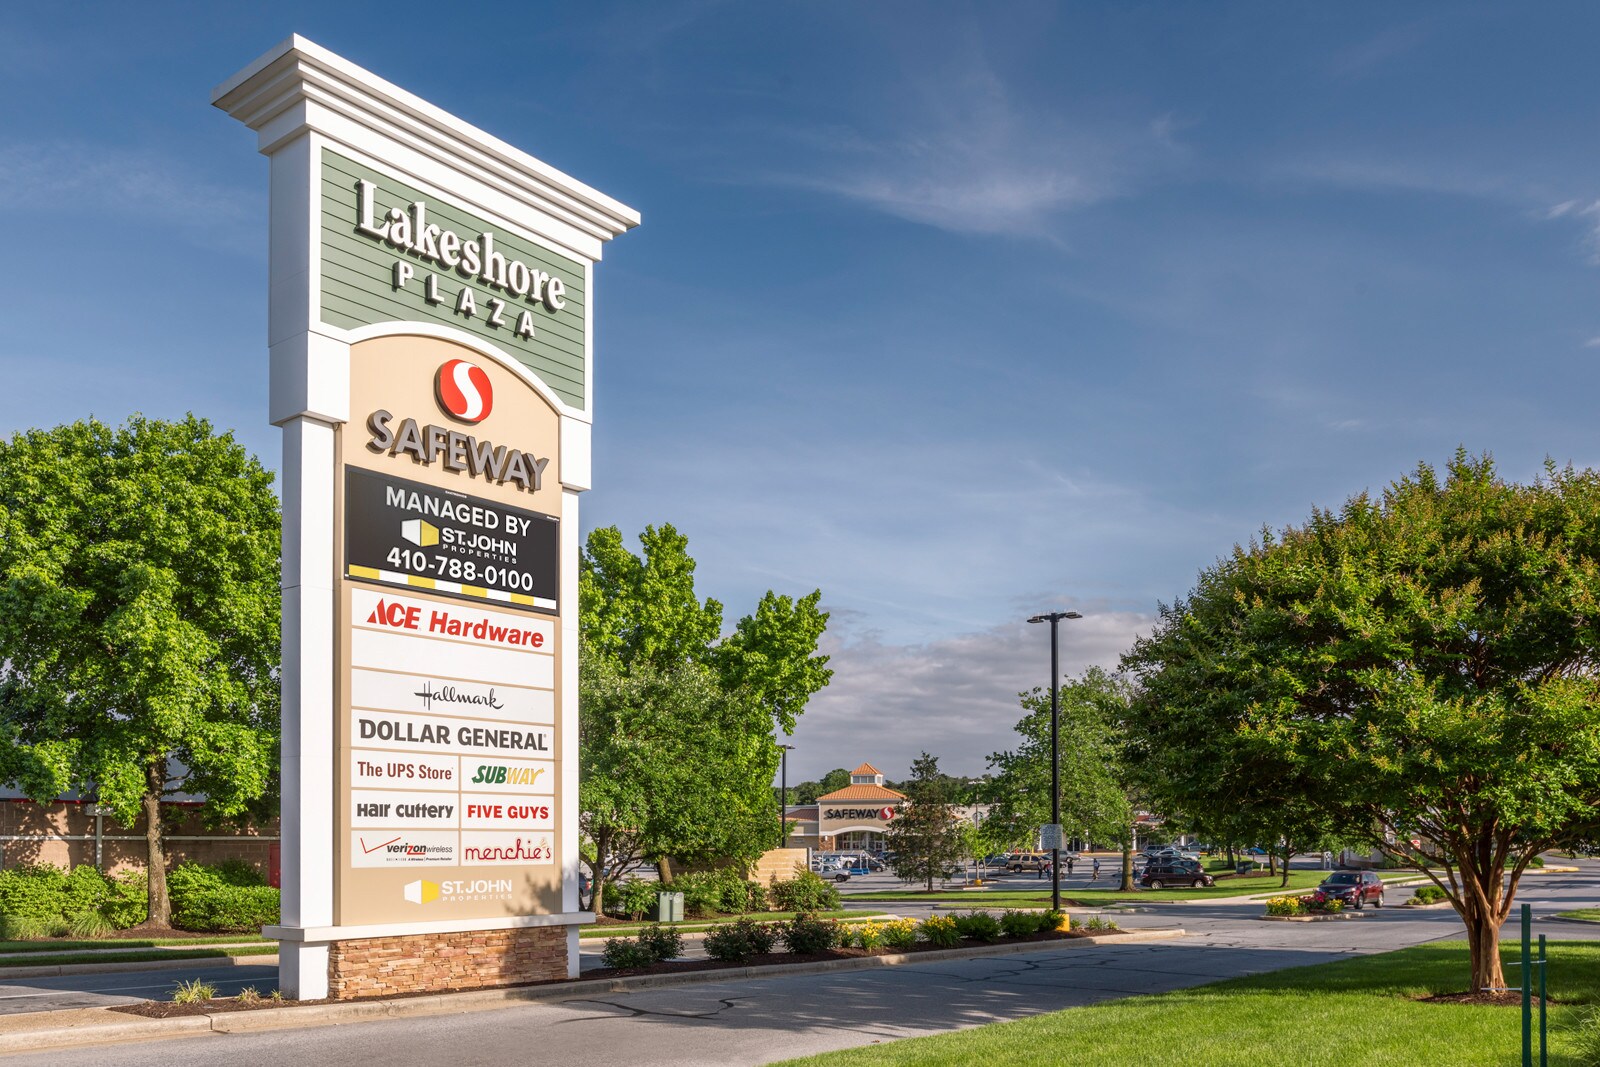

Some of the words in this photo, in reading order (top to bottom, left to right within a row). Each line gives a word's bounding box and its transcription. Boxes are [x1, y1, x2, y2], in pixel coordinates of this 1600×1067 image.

[356, 179, 566, 311] Lakeshore
[395, 261, 536, 338] PLAZA
[366, 409, 549, 493] SAFEWAY
[386, 486, 498, 529] MANAGED
[506, 514, 531, 537] BY
[442, 544, 517, 564] PROPERTIES
[387, 547, 533, 591] 410-788-0100
[367, 598, 421, 630] ACE
[429, 611, 544, 648] Hardware
[414, 681, 504, 710] Hallmark
[359, 719, 450, 744] DOLLAR
[457, 727, 548, 751] GENERAL
[357, 761, 383, 777] The
[387, 763, 414, 779] UPS
[419, 764, 452, 780] Store
[471, 765, 545, 785] SUBWAY
[357, 803, 391, 818] Hair
[396, 803, 454, 819] cuttery
[467, 804, 503, 819] FIVE
[507, 805, 549, 820] GUYS
[826, 808, 880, 820] SAFEWAY
[465, 837, 551, 861] menchie's
[442, 894, 513, 902] PROPERTIES
